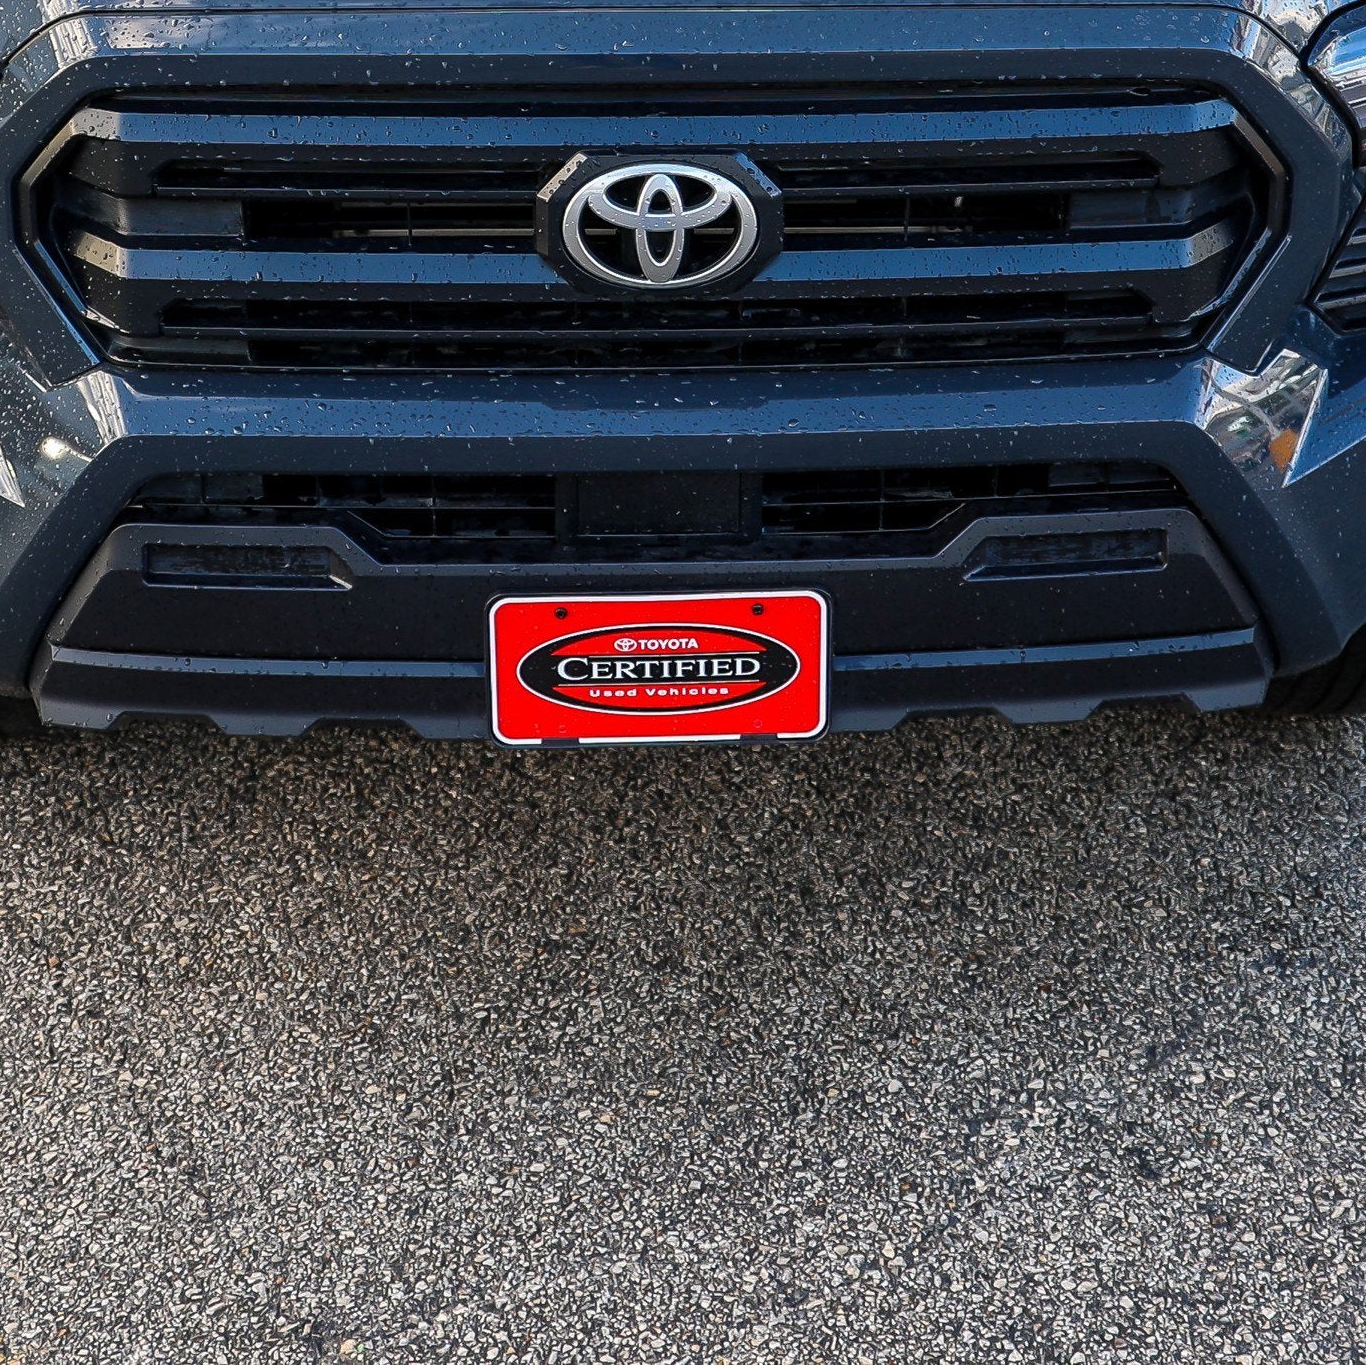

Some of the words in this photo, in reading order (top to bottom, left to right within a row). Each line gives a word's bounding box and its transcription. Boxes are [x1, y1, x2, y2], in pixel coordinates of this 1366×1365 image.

[638, 638, 698, 650] TOYOTA
[557, 657, 761, 681] CERTIFIED
[589, 688, 637, 698] Used
[645, 686, 730, 697] Vehicles
